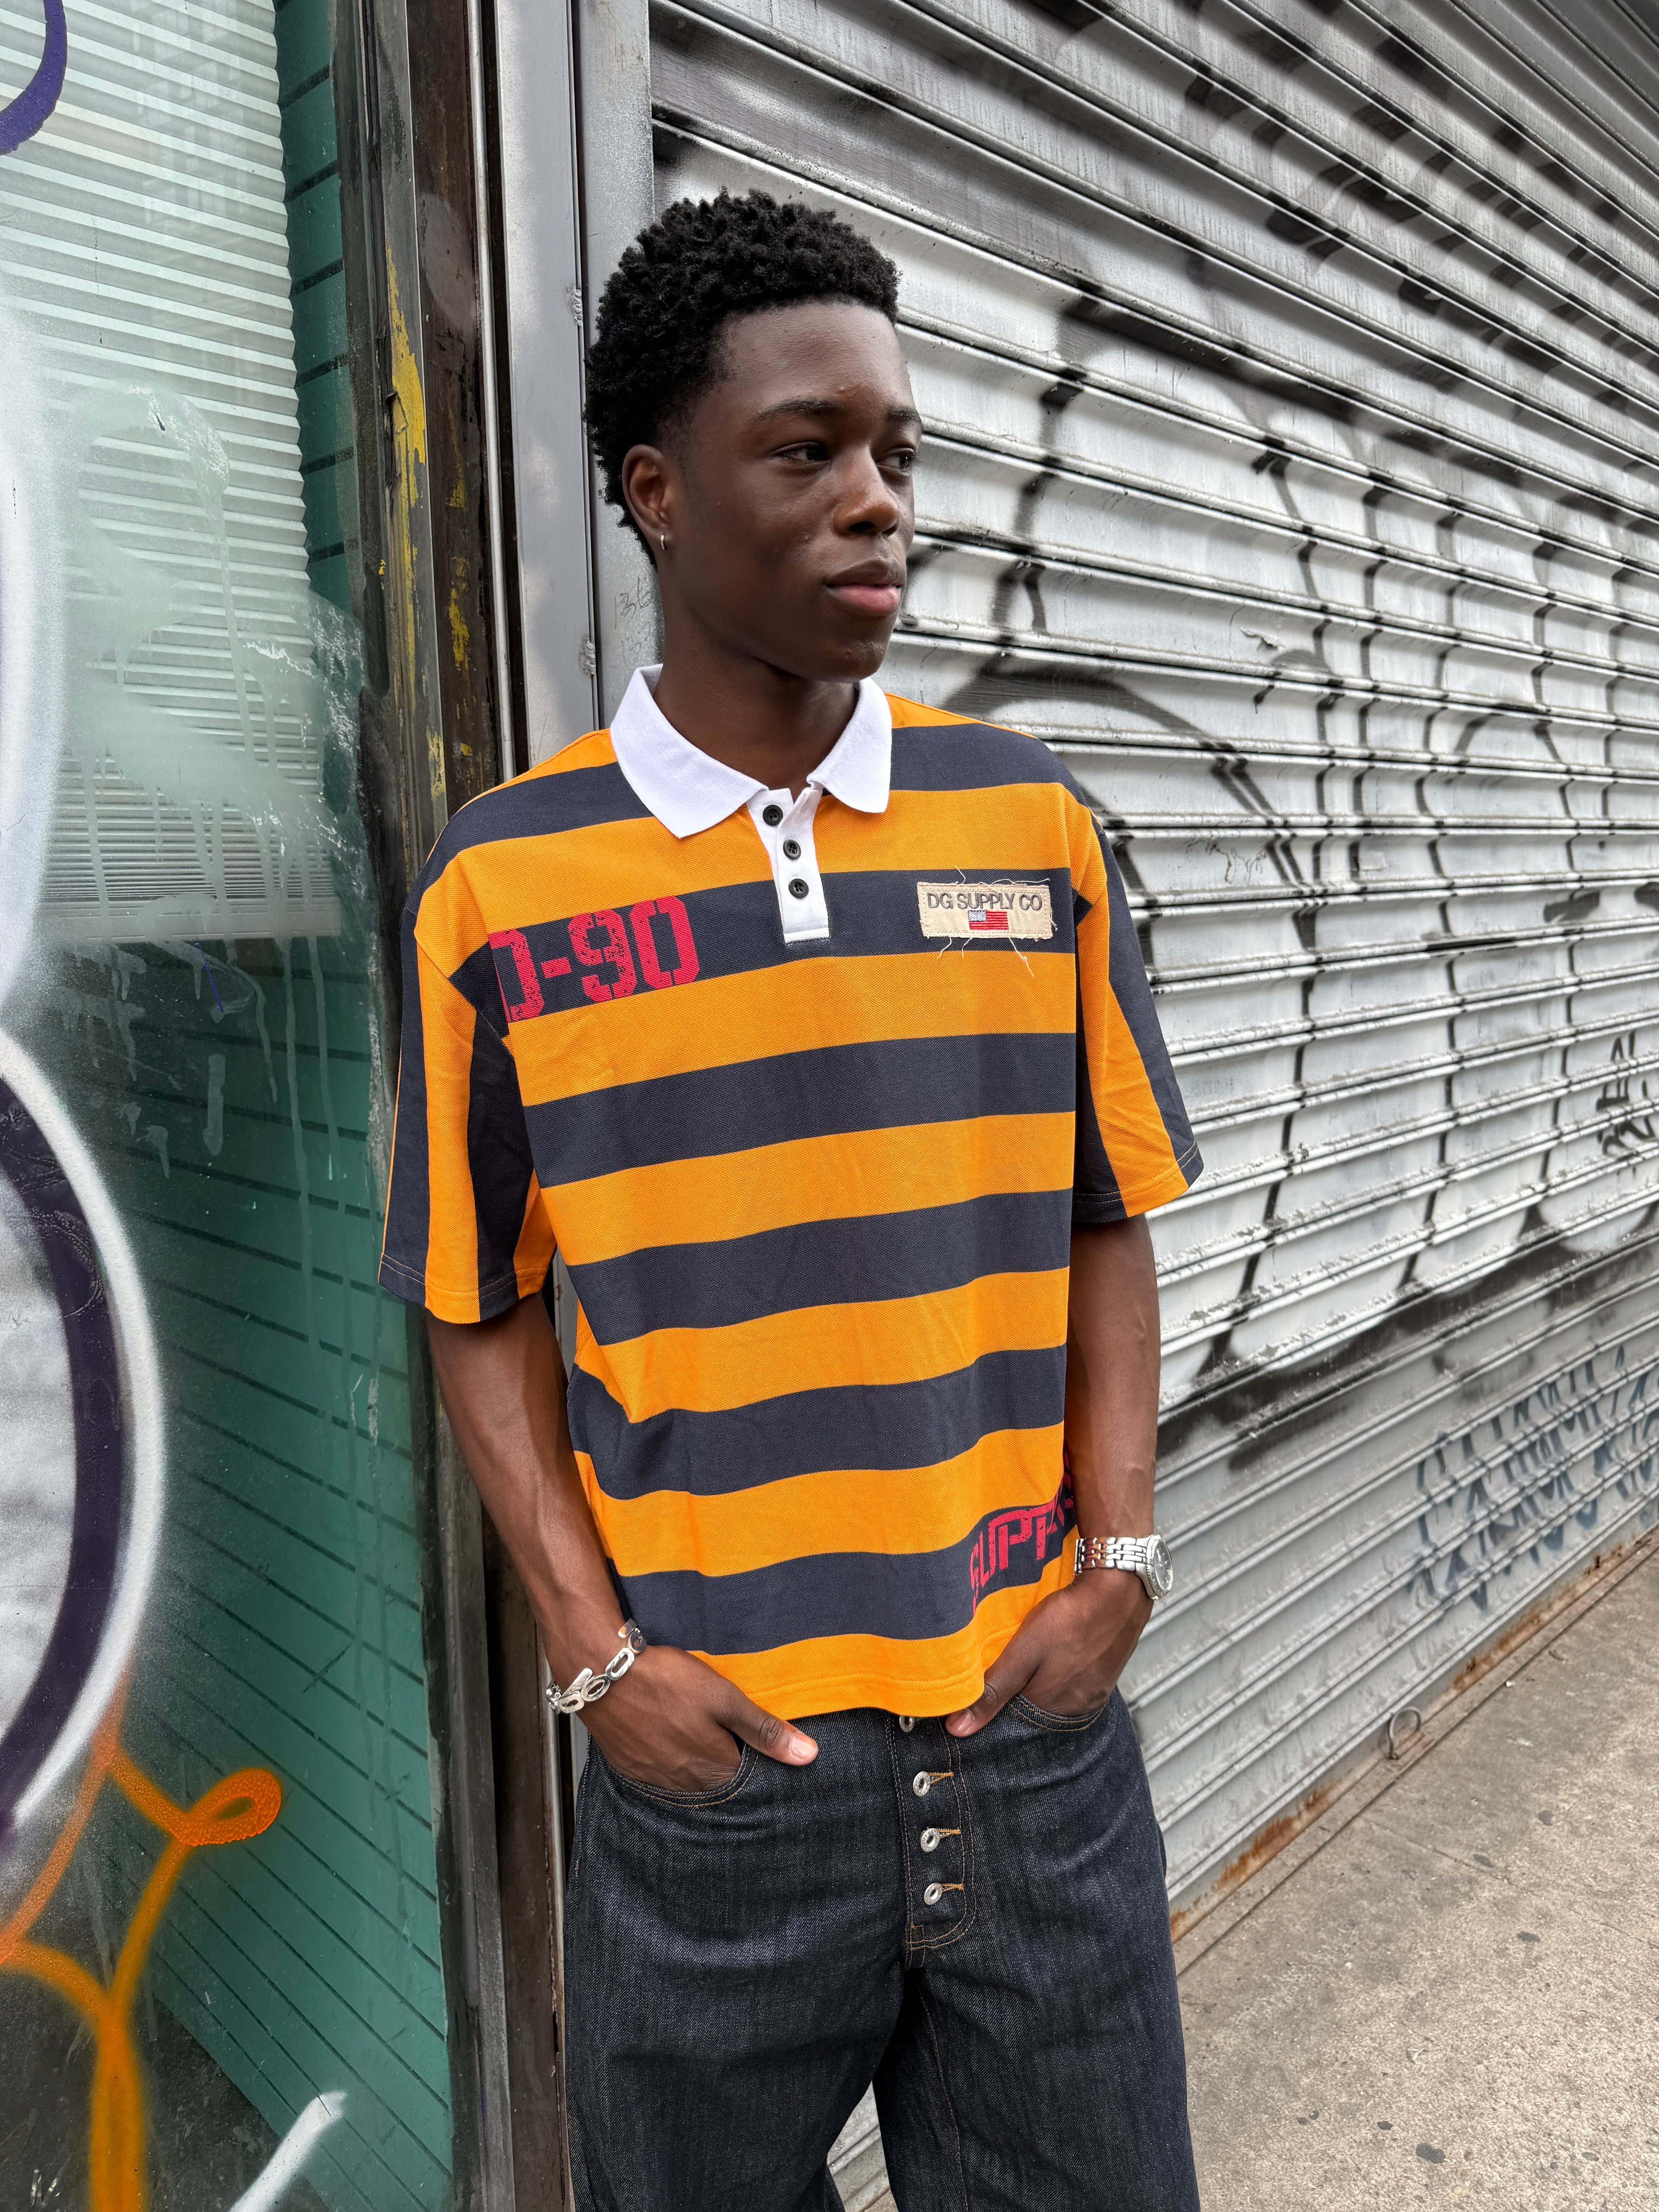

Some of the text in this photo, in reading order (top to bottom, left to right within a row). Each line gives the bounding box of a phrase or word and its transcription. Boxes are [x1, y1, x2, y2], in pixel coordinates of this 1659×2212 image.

[927, 892, 1042, 911] DG SUPPLY CO
